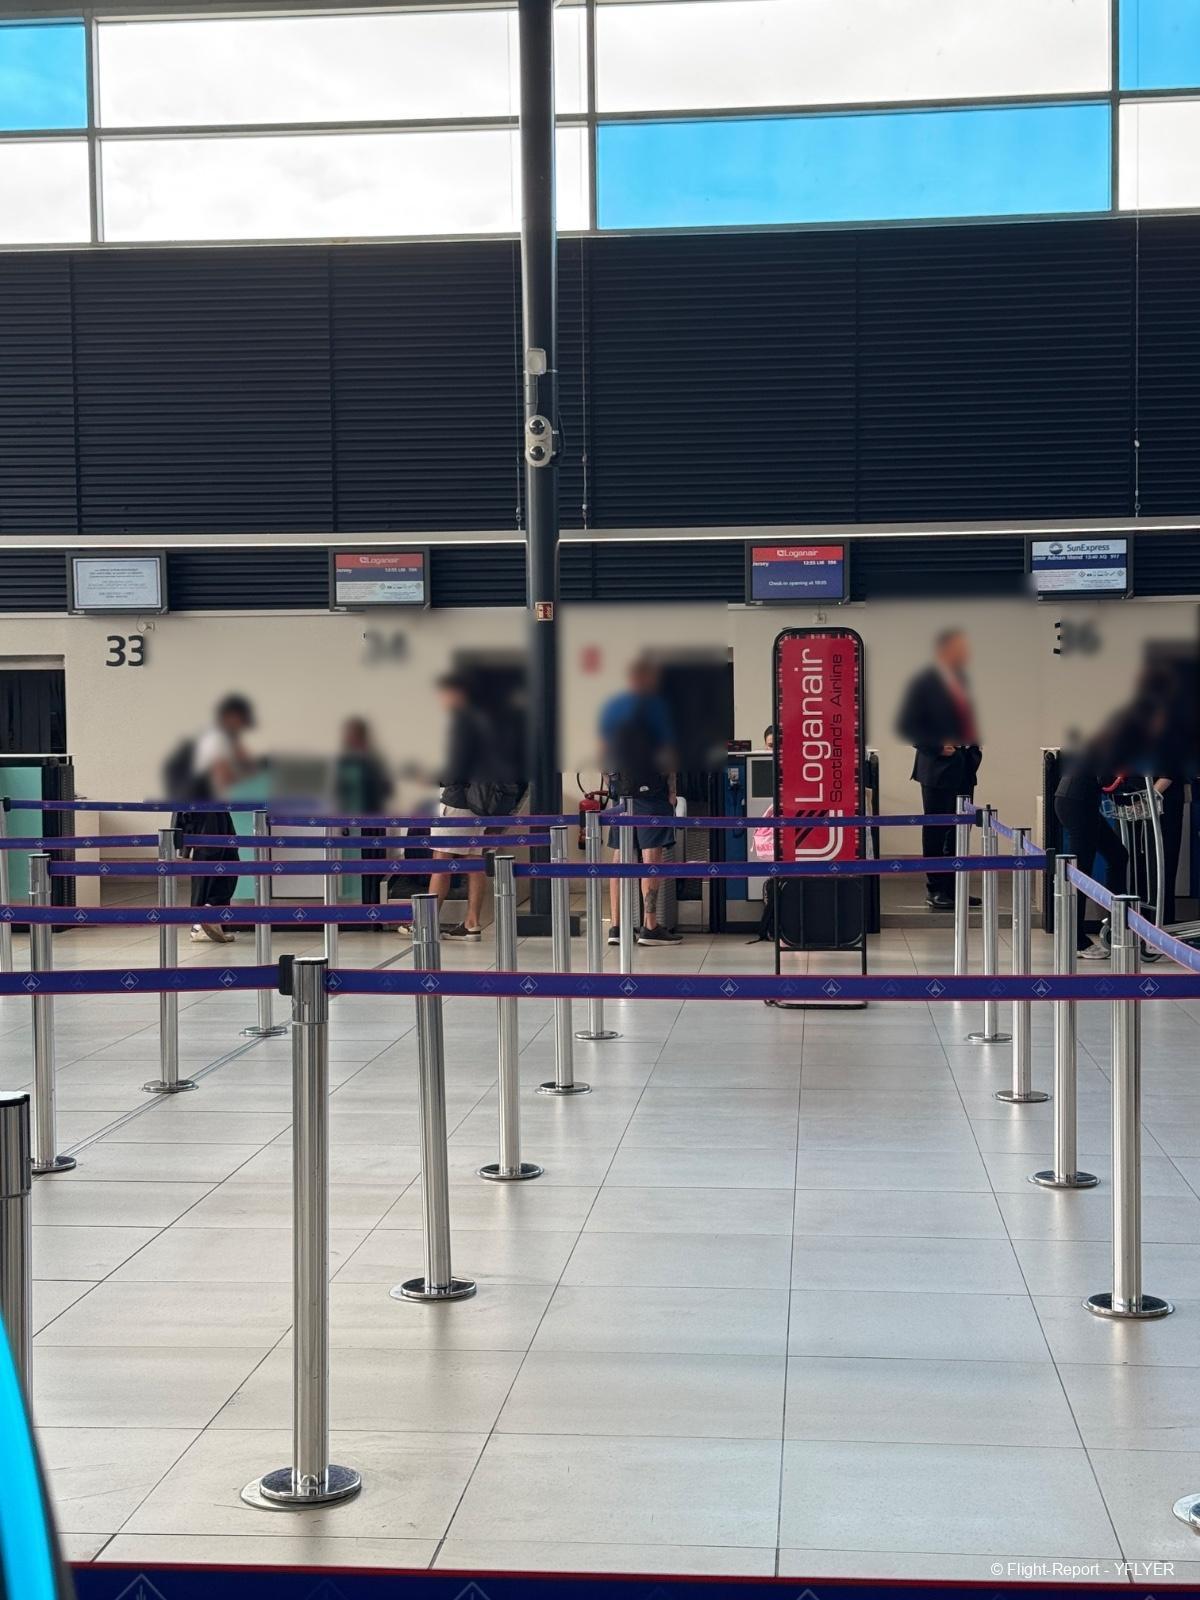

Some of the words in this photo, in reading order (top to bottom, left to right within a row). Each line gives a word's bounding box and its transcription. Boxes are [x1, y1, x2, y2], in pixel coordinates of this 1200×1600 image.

[368, 557, 399, 565] Loganair
[784, 549, 819, 557] Loganair
[1067, 543, 1110, 552] SunExpress
[105, 635, 144, 667] 33
[829, 653, 843, 707] Airline
[794, 648, 832, 803] Loganair
[830, 713, 843, 803] Scotland's
